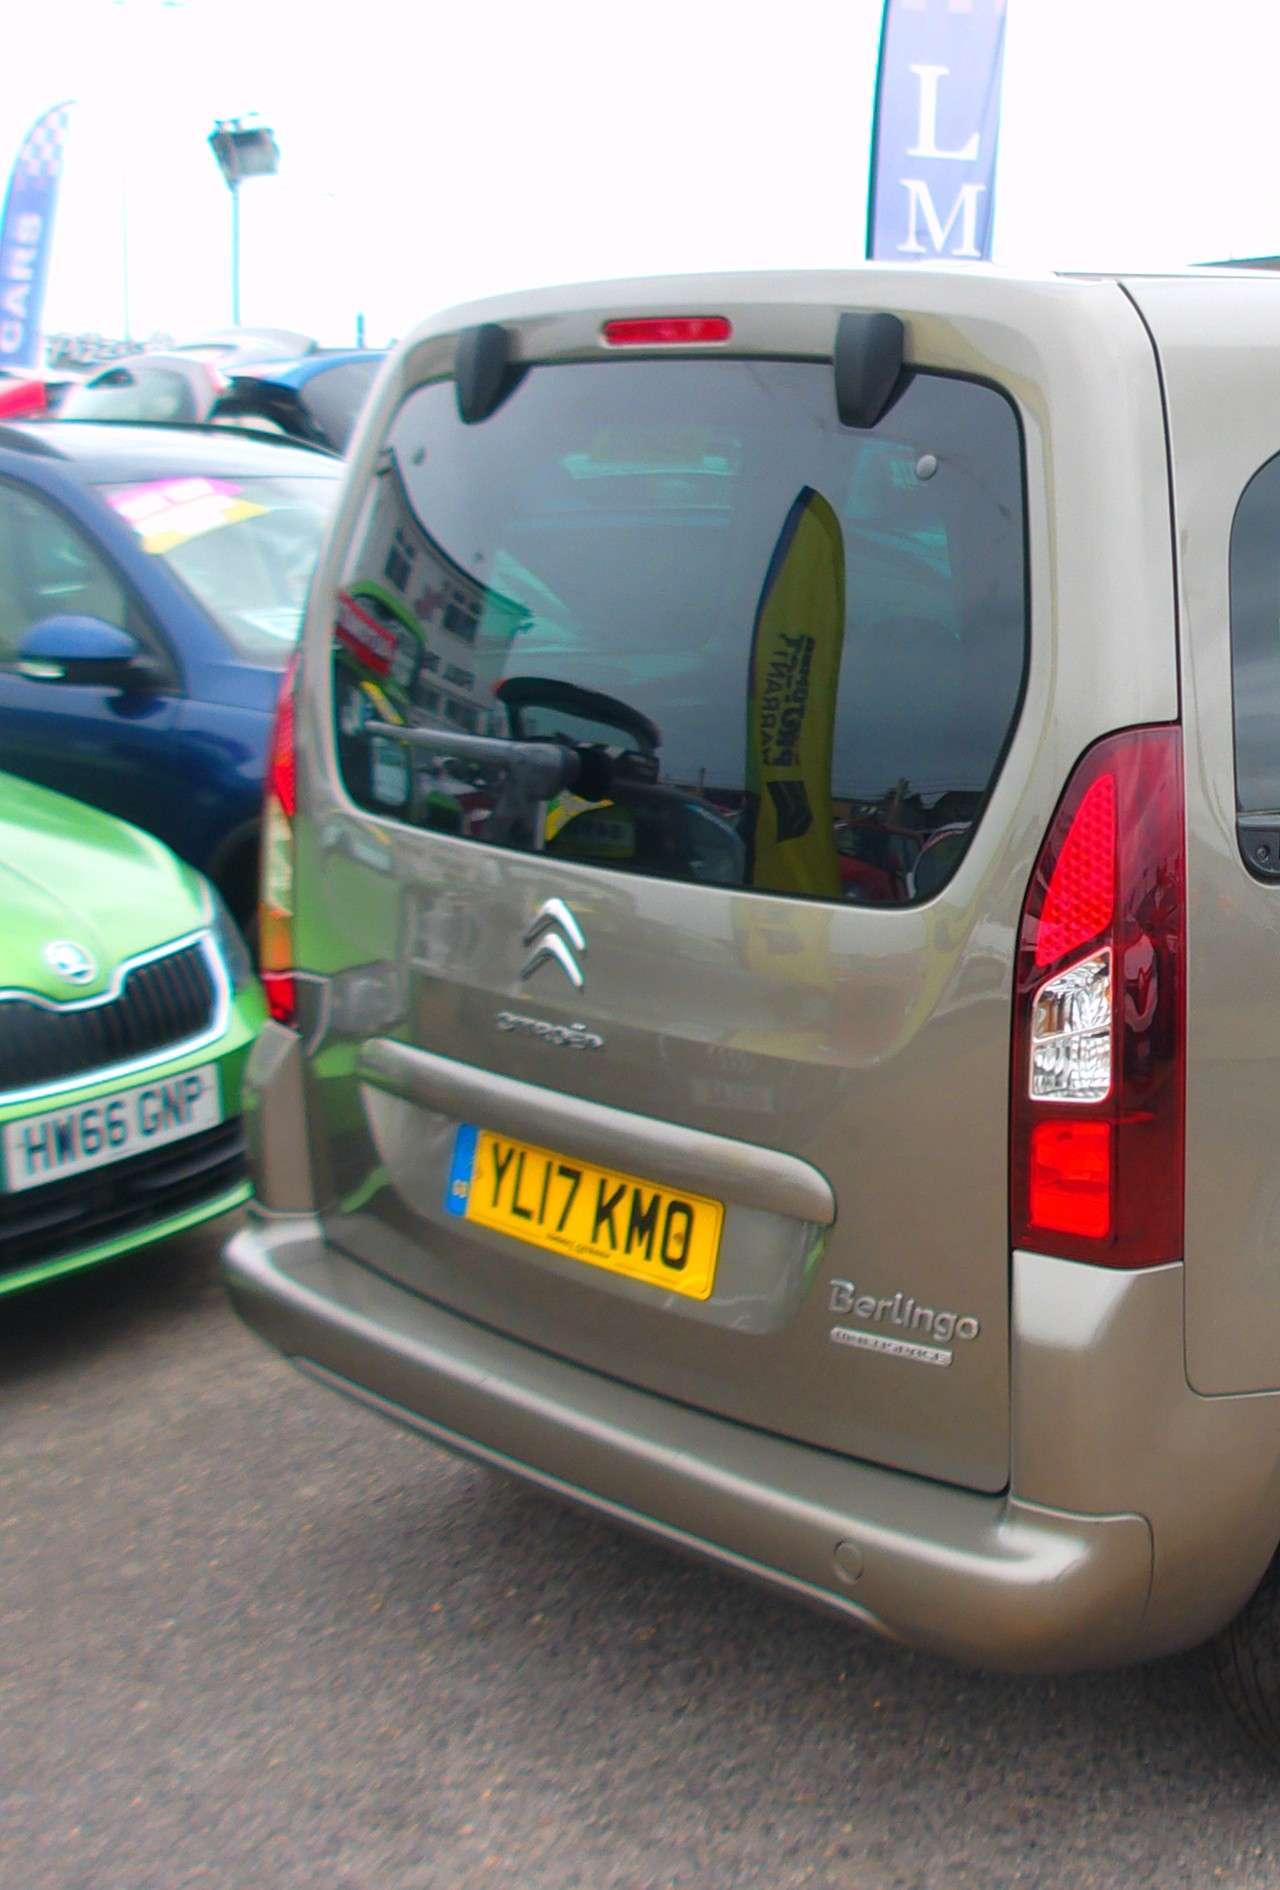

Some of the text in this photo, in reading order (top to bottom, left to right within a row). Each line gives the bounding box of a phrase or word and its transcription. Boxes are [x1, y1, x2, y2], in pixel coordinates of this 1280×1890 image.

[0, 213, 41, 354] CARS
[23, 1074, 206, 1175] HW66 GNP
[492, 1141, 694, 1270] YL17 KMO
[829, 1278, 981, 1343] Berlingo
